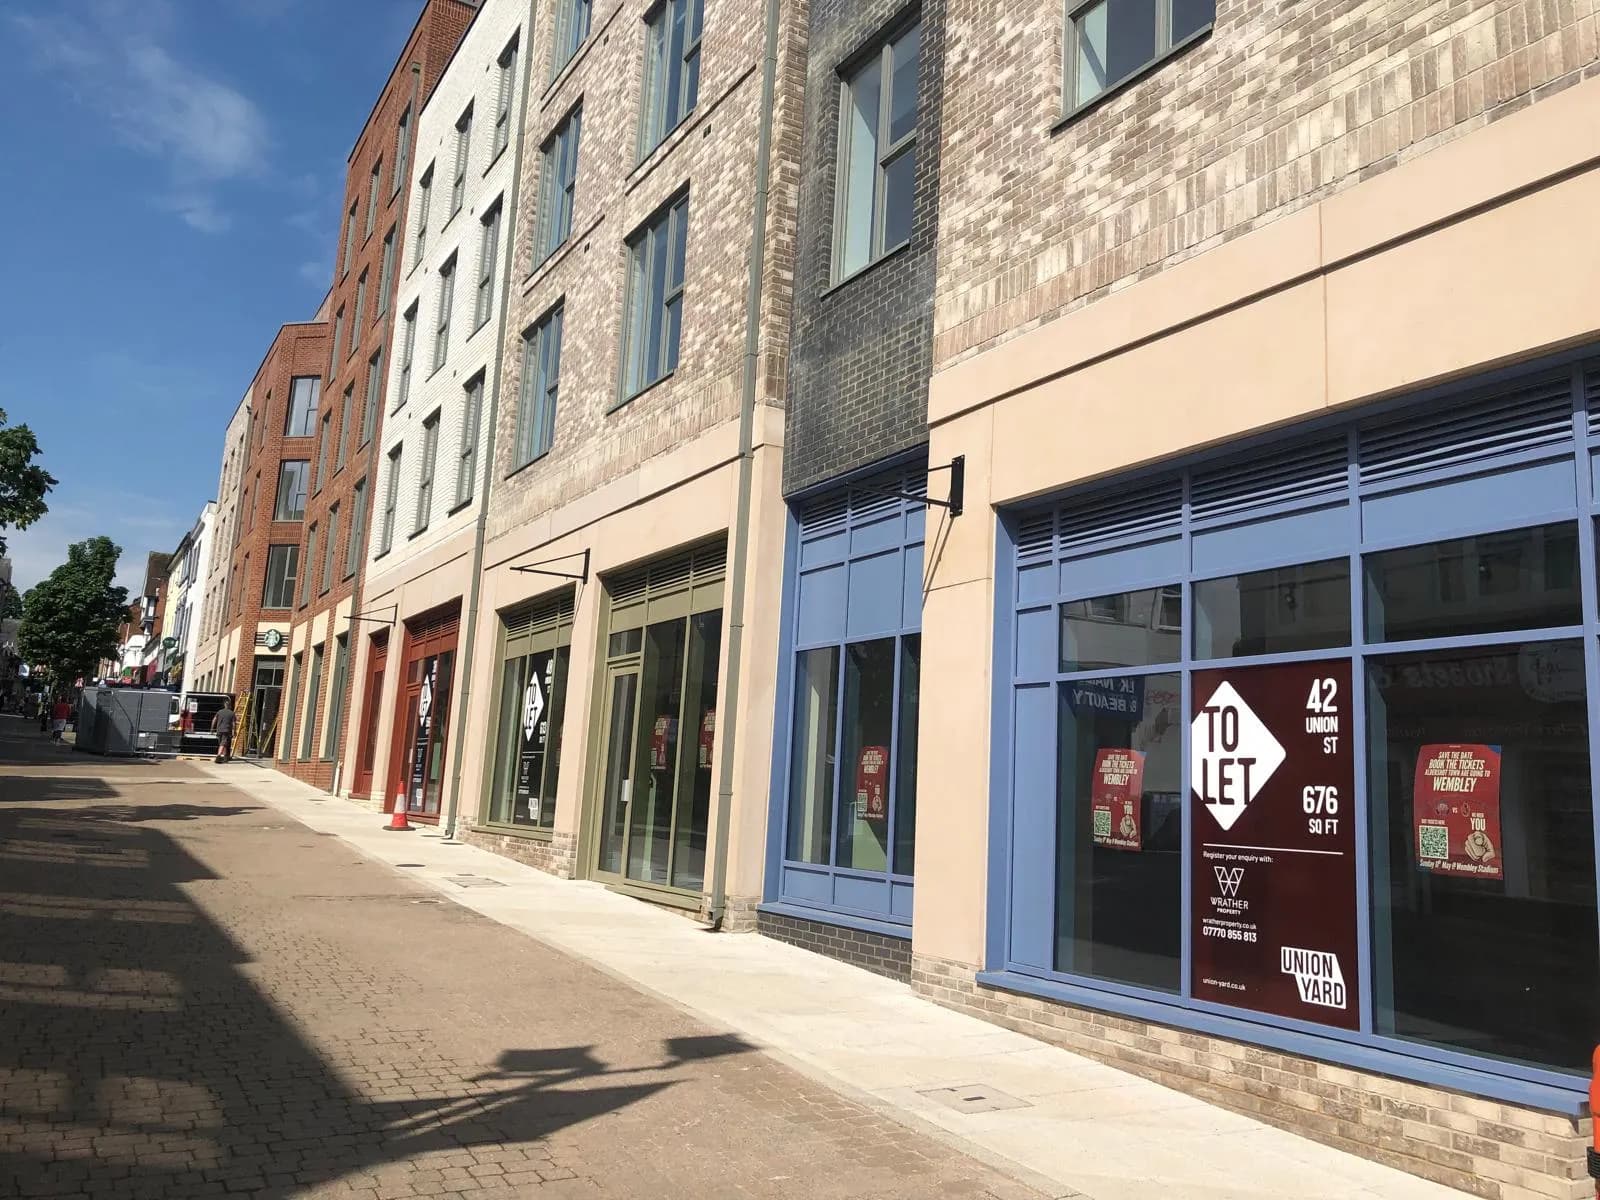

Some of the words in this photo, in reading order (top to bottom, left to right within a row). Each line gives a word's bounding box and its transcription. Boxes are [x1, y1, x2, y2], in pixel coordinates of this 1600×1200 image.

[1306, 678, 1338, 713] 42
[1203, 705, 1239, 752] TO
[1306, 716, 1339, 733] UNION
[1323, 737, 1339, 754] ST
[1438, 751, 1450, 759] SAVE
[1446, 759, 1458, 769] THE
[1459, 760, 1486, 770] TICKETS
[1202, 758, 1257, 805] LET
[1433, 776, 1477, 793] WEMBLEY
[1303, 786, 1338, 814] 676
[1308, 818, 1322, 834] SQ
[1325, 818, 1339, 834] FT
[1470, 818, 1486, 831] YOU
[1203, 850, 1225, 859] Register
[1225, 853, 1238, 861] your
[1238, 854, 1258, 863] enquiry
[1259, 855, 1274, 863] with:
[1210, 896, 1249, 909] WRATHER
[1216, 907, 1241, 915] PROPERTY
[1202, 918, 1257, 930] wratherproperty.co.uk
[1203, 925, 1226, 938] 07770
[1227, 929, 1242, 941] 855
[1243, 931, 1257, 943] 813
[1282, 949, 1333, 978] UNION
[1202, 977, 1246, 991] union-yard.co.uk
[1301, 977, 1344, 1006] YARD
